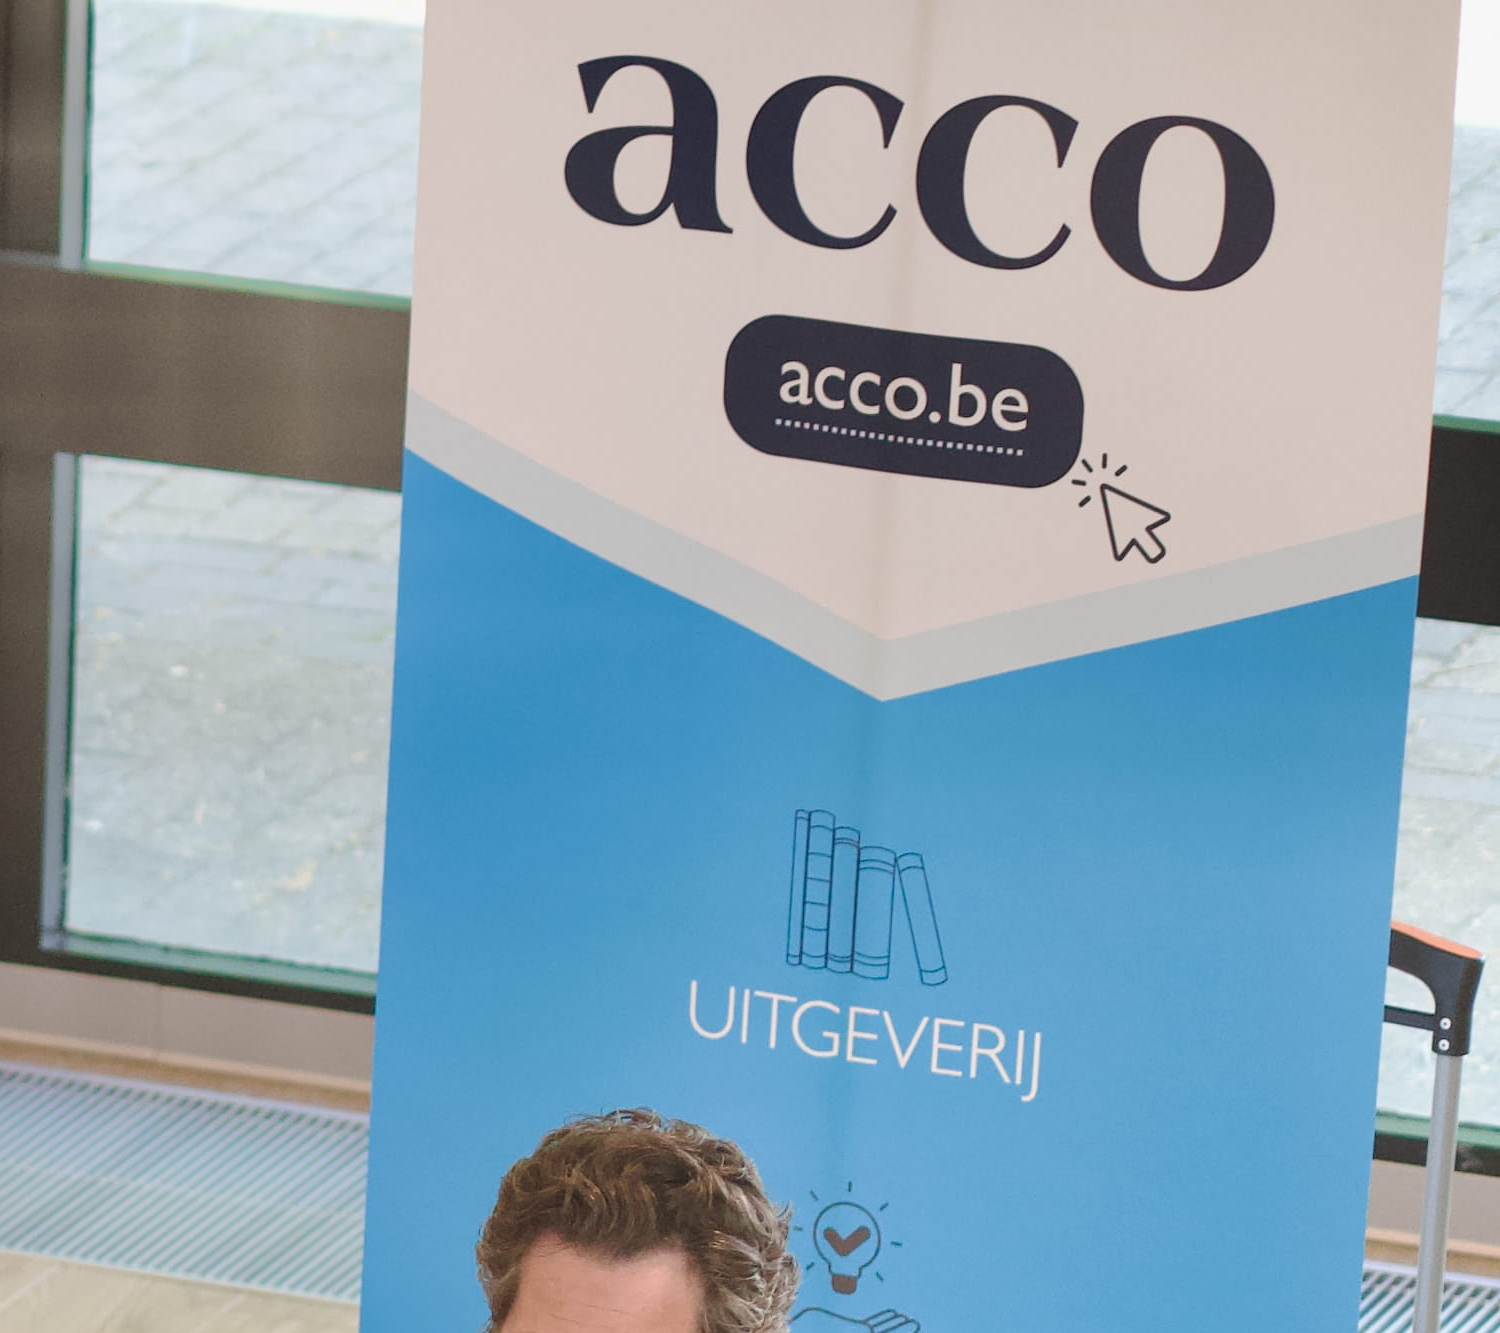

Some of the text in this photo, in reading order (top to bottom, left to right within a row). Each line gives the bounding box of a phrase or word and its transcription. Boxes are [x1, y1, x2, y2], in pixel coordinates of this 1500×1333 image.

[563, 54, 1276, 292] acco
[778, 359, 1030, 434] acco.be
[686, 979, 1045, 1103] UITGEVERIJ
